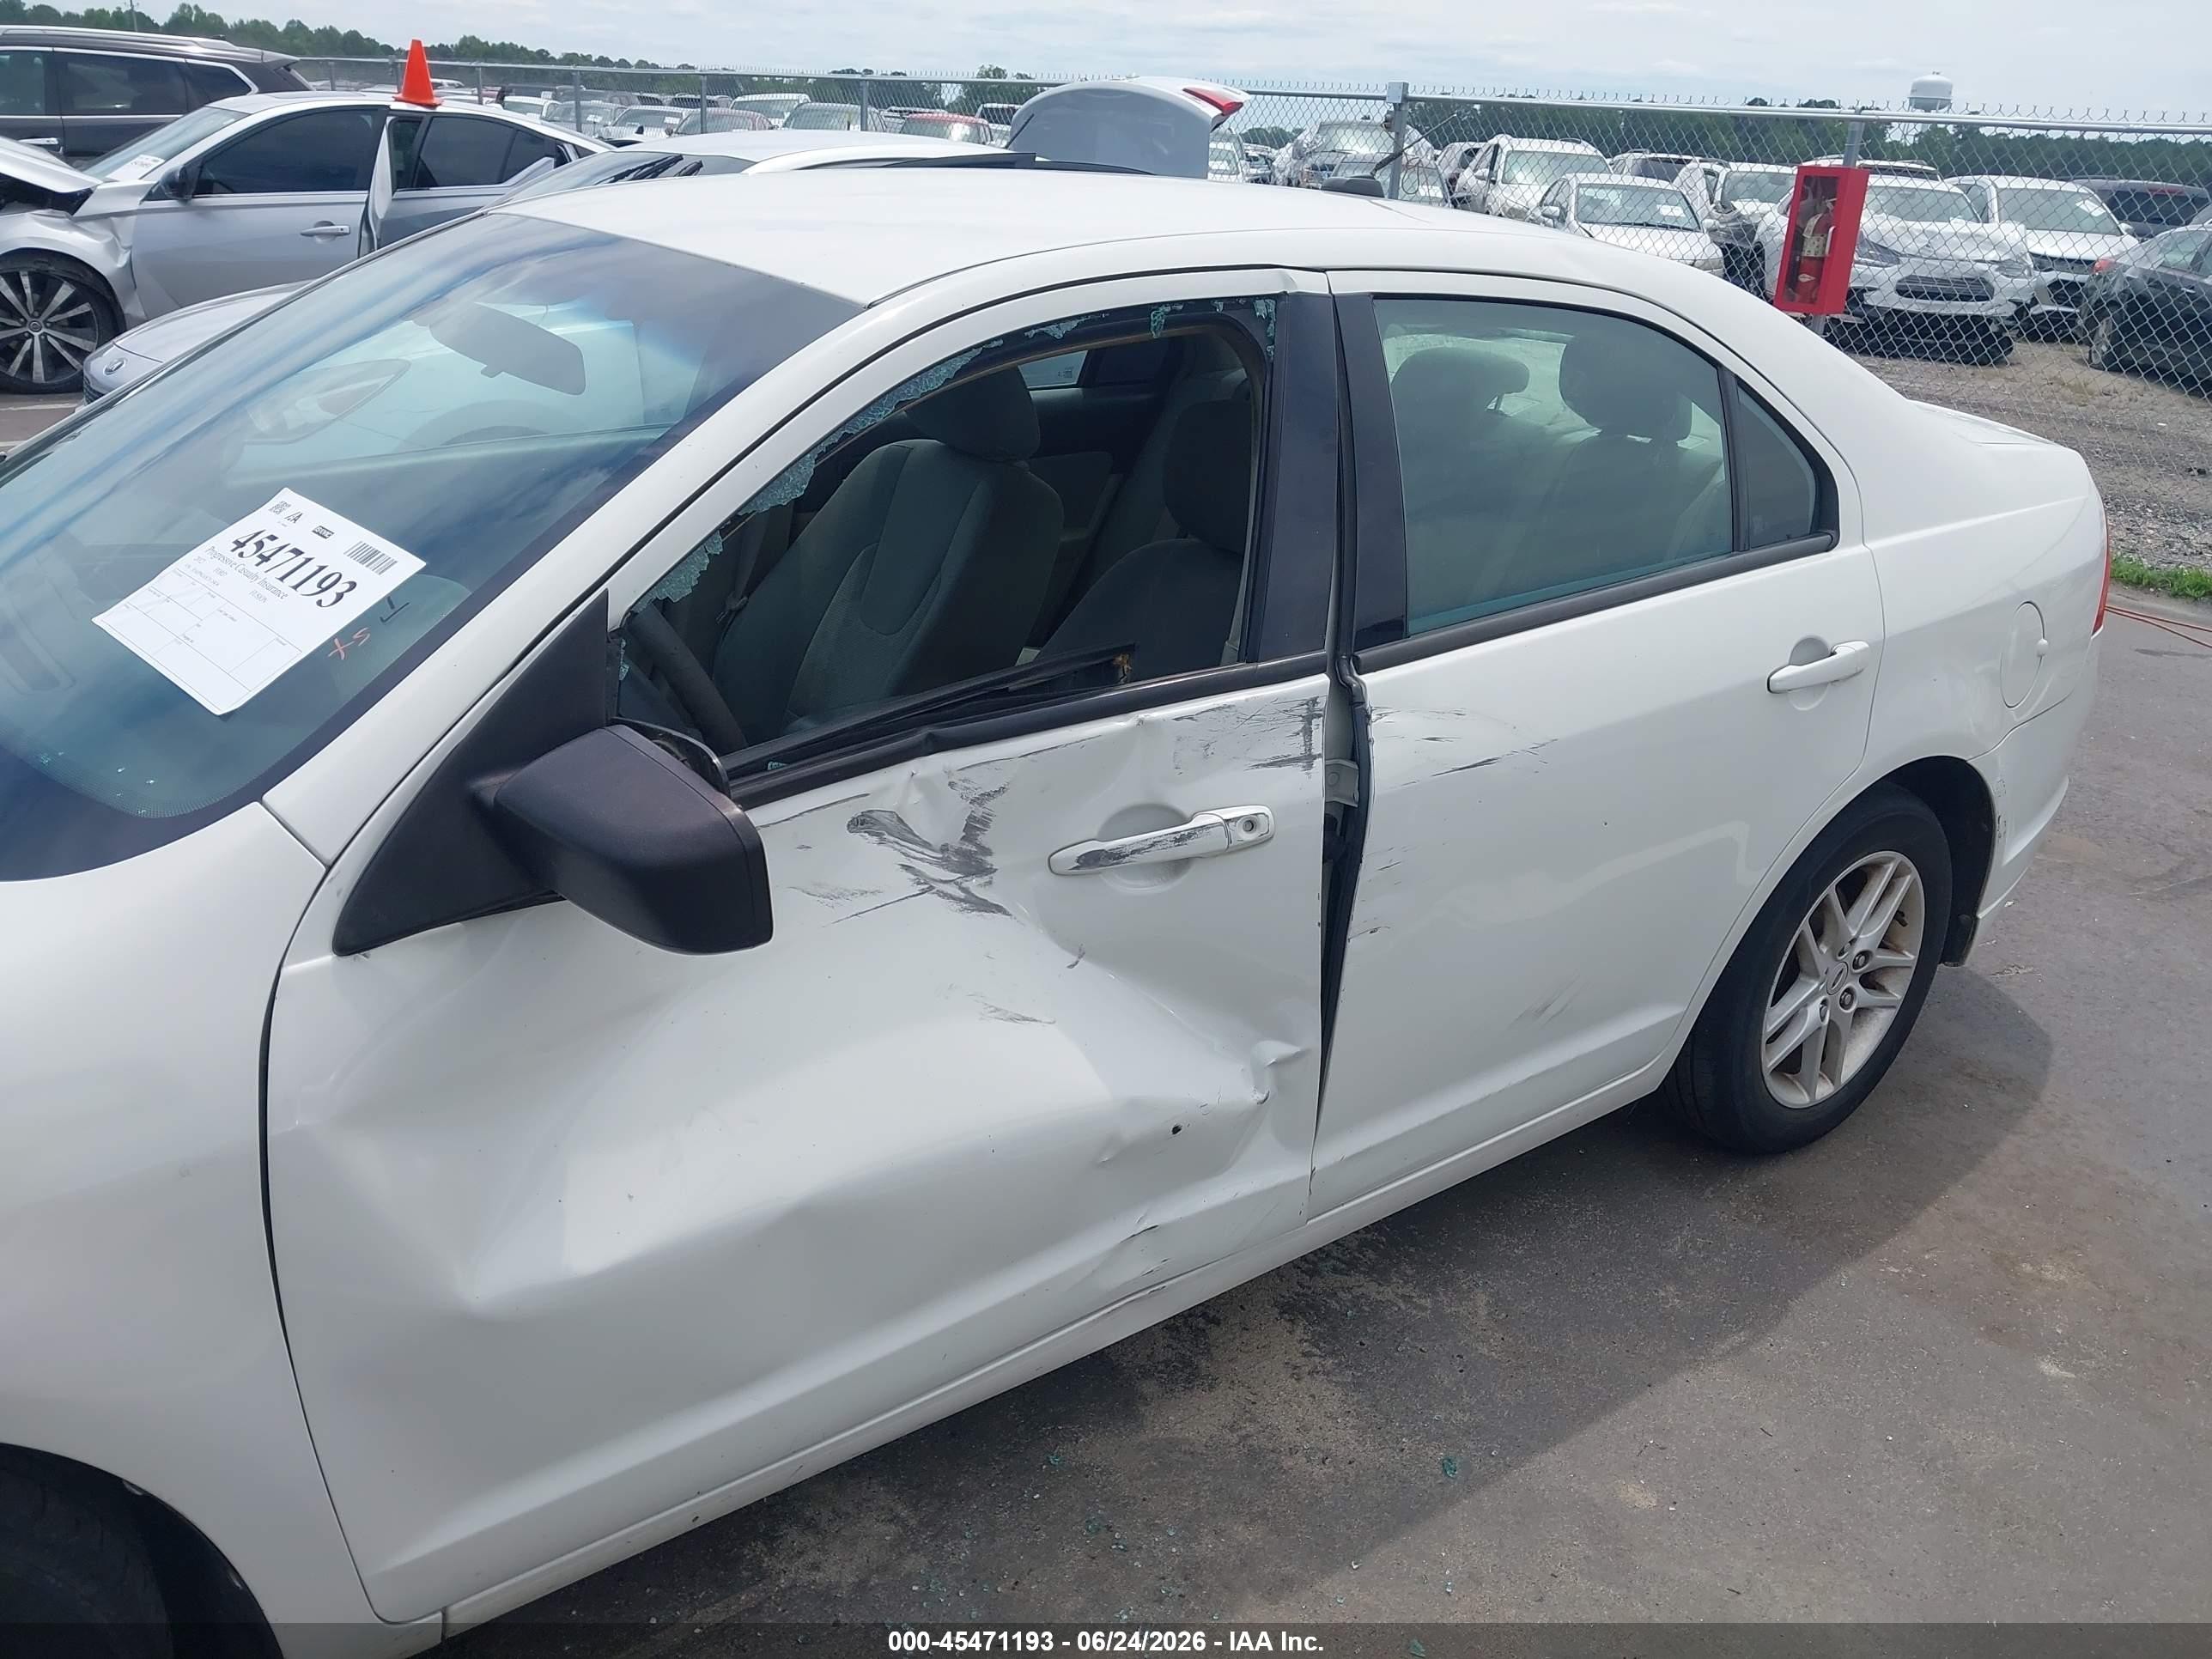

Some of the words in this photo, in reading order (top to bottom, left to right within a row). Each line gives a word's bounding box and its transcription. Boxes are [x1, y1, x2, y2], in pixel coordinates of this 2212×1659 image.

[205, 545, 236, 568] Progressive
[234, 563, 261, 584] Casualty
[258, 577, 289, 599] Insurance
[230, 529, 357, 608] 45471193
